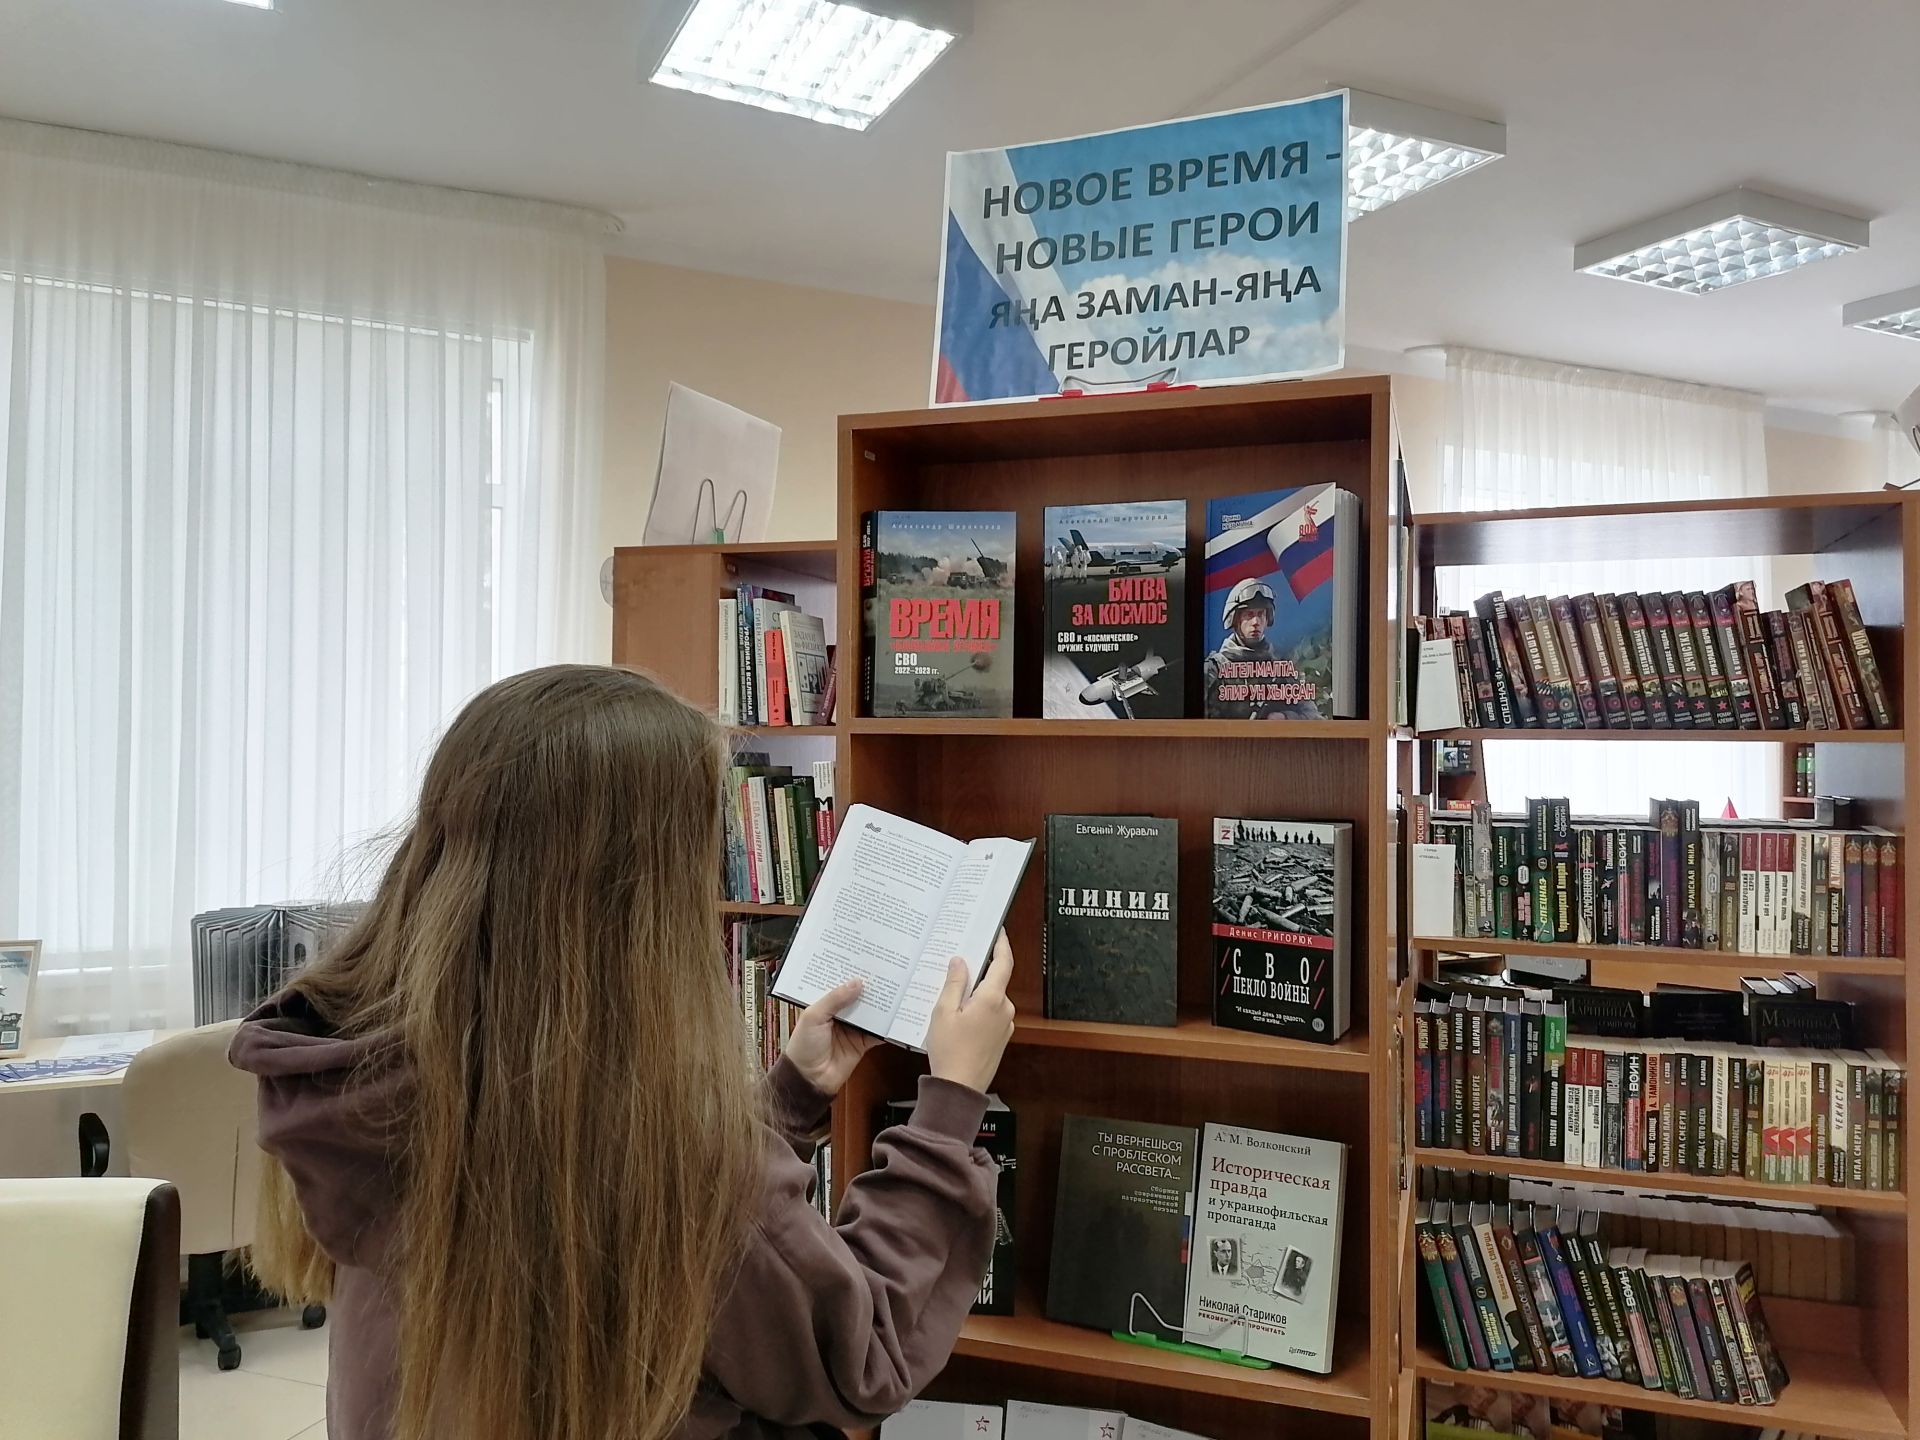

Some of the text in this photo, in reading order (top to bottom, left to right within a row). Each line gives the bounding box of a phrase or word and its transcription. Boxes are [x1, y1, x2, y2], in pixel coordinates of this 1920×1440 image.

[983, 167, 1133, 220] НОВОЕ
[1148, 141, 1309, 197] ВРЕМЯ
[996, 201, 1319, 275] НОВЫЕ ГЕРОИ
[989, 265, 1322, 332] ЯҢА ЗАМАН-ЯҢА
[1048, 325, 1250, 373] ГЕРОЙЛАР
[1109, 577, 1168, 601] БИТВА
[889, 597, 1001, 640] ВРЕМЯ
[1072, 602, 1168, 626] ЗА КОСМОС
[1057, 631, 1075, 643] СВО
[1057, 643, 1119, 653] ОРУЖИЕ БУДУЩЕГО
[1524, 631, 1544, 670] РИКОШЕТ
[1678, 632, 1697, 672] ЗАЧИСТКА
[1701, 627, 1719, 676] ПРИЗРАКИ НОЧИ
[894, 652, 918, 667] СВО
[1796, 640, 1812, 685] ГОРНАЯ БАЗА
[1218, 684, 1249, 701] ЭПИР
[1249, 684, 1265, 701] УН
[1497, 681, 1512, 724] СПЕЦНАЗ
[1076, 824, 1159, 838] Евгений Журавли
[1605, 833, 1614, 870] Тамоников
[1618, 833, 1627, 867] ВОИН
[1831, 836, 1841, 878] ТАМОНИКОВ
[1687, 843, 1696, 908] ИРАНСКАЯ МИНА
[1058, 887, 1170, 911] ЛИНИЯ
[1539, 877, 1549, 924] СПЕЦНАЗ
[1583, 868, 1594, 918] ТАМОНИКОВ
[1058, 906, 1170, 921] СОПРИКОСНОВЕНИЯ
[1229, 926, 1313, 946] Денис ГРИГОРЮК
[1233, 975, 1310, 1005] ПЕКЛО ВОЙНЫ
[1455, 1012, 1463, 1043] ШАРАПОВ
[1472, 1016, 1481, 1047] ШАРАПОВ
[1629, 1056, 1639, 1091] ВОИН
[1649, 1056, 1657, 1098] ТАМОНИКОВ
[1455, 1079, 1463, 1111] СМЕРТИ
[1472, 1074, 1481, 1111] КОНВЕРТЕ
[1835, 1079, 1844, 1130] ЧЕКИСТЫ
[1098, 1131, 1184, 1152] ТЫ ВЕРНЕШЬСЯ
[1472, 1119, 1481, 1147] СМЕРТЬ
[1648, 1117, 1657, 1164] ЧЕРНОЕ СОЛНЦЕ
[1662, 1103, 1671, 1167] СТАЛЬНАЯ ПАМЯТЬ
[1679, 1110, 1687, 1141] СМЕРТИ
[1092, 1146, 1182, 1166] С ПРОБЛЕСКОМ
[1214, 1132, 1311, 1156] А. М. Волконский
[1853, 1123, 1862, 1181] ИГЛА СМЕРТИ
[1209, 1180, 1268, 1199] правда
[1211, 1156, 1331, 1191] Историческая
[1207, 1211, 1277, 1231] пропаганда
[1208, 1198, 1328, 1227] и украинофильская
[1578, 1269, 1594, 1301] ВОСТОКА
[1618, 1270, 1637, 1307] ВОИН
[1198, 1295, 1288, 1326] Николай Стариков
[1591, 1307, 1605, 1335] ЦИКЛОН
[1611, 1311, 1625, 1337] БРОСОК
[1480, 1305, 1498, 1354] СПЕЦИАЛЬНАЯ
[1488, 1312, 1503, 1345] КОМАНДА
[1714, 1359, 1727, 1387] СУХОВ
